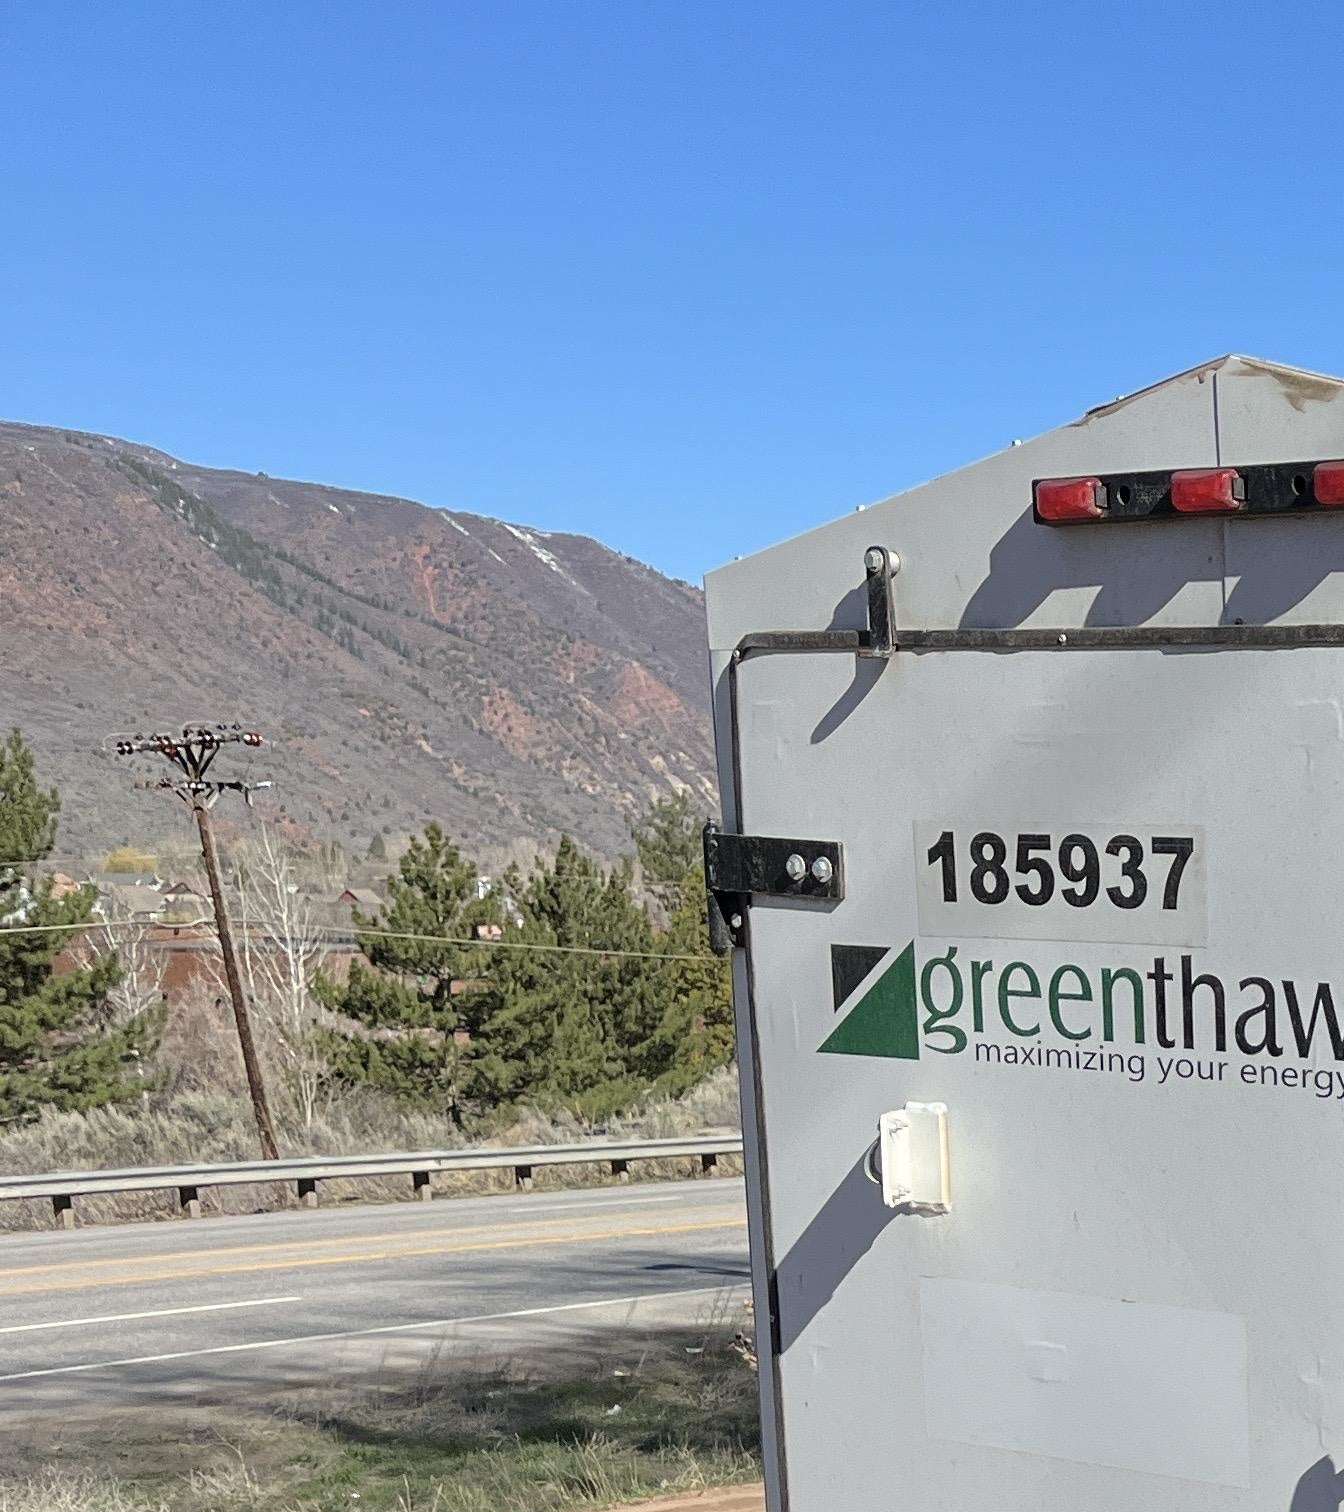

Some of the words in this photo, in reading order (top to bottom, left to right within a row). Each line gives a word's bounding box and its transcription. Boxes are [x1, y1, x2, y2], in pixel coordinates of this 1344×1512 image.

[928, 831, 1193, 910] 185937
[975, 1039, 1146, 1082] maximizing
[1157, 1057, 1229, 1084] your
